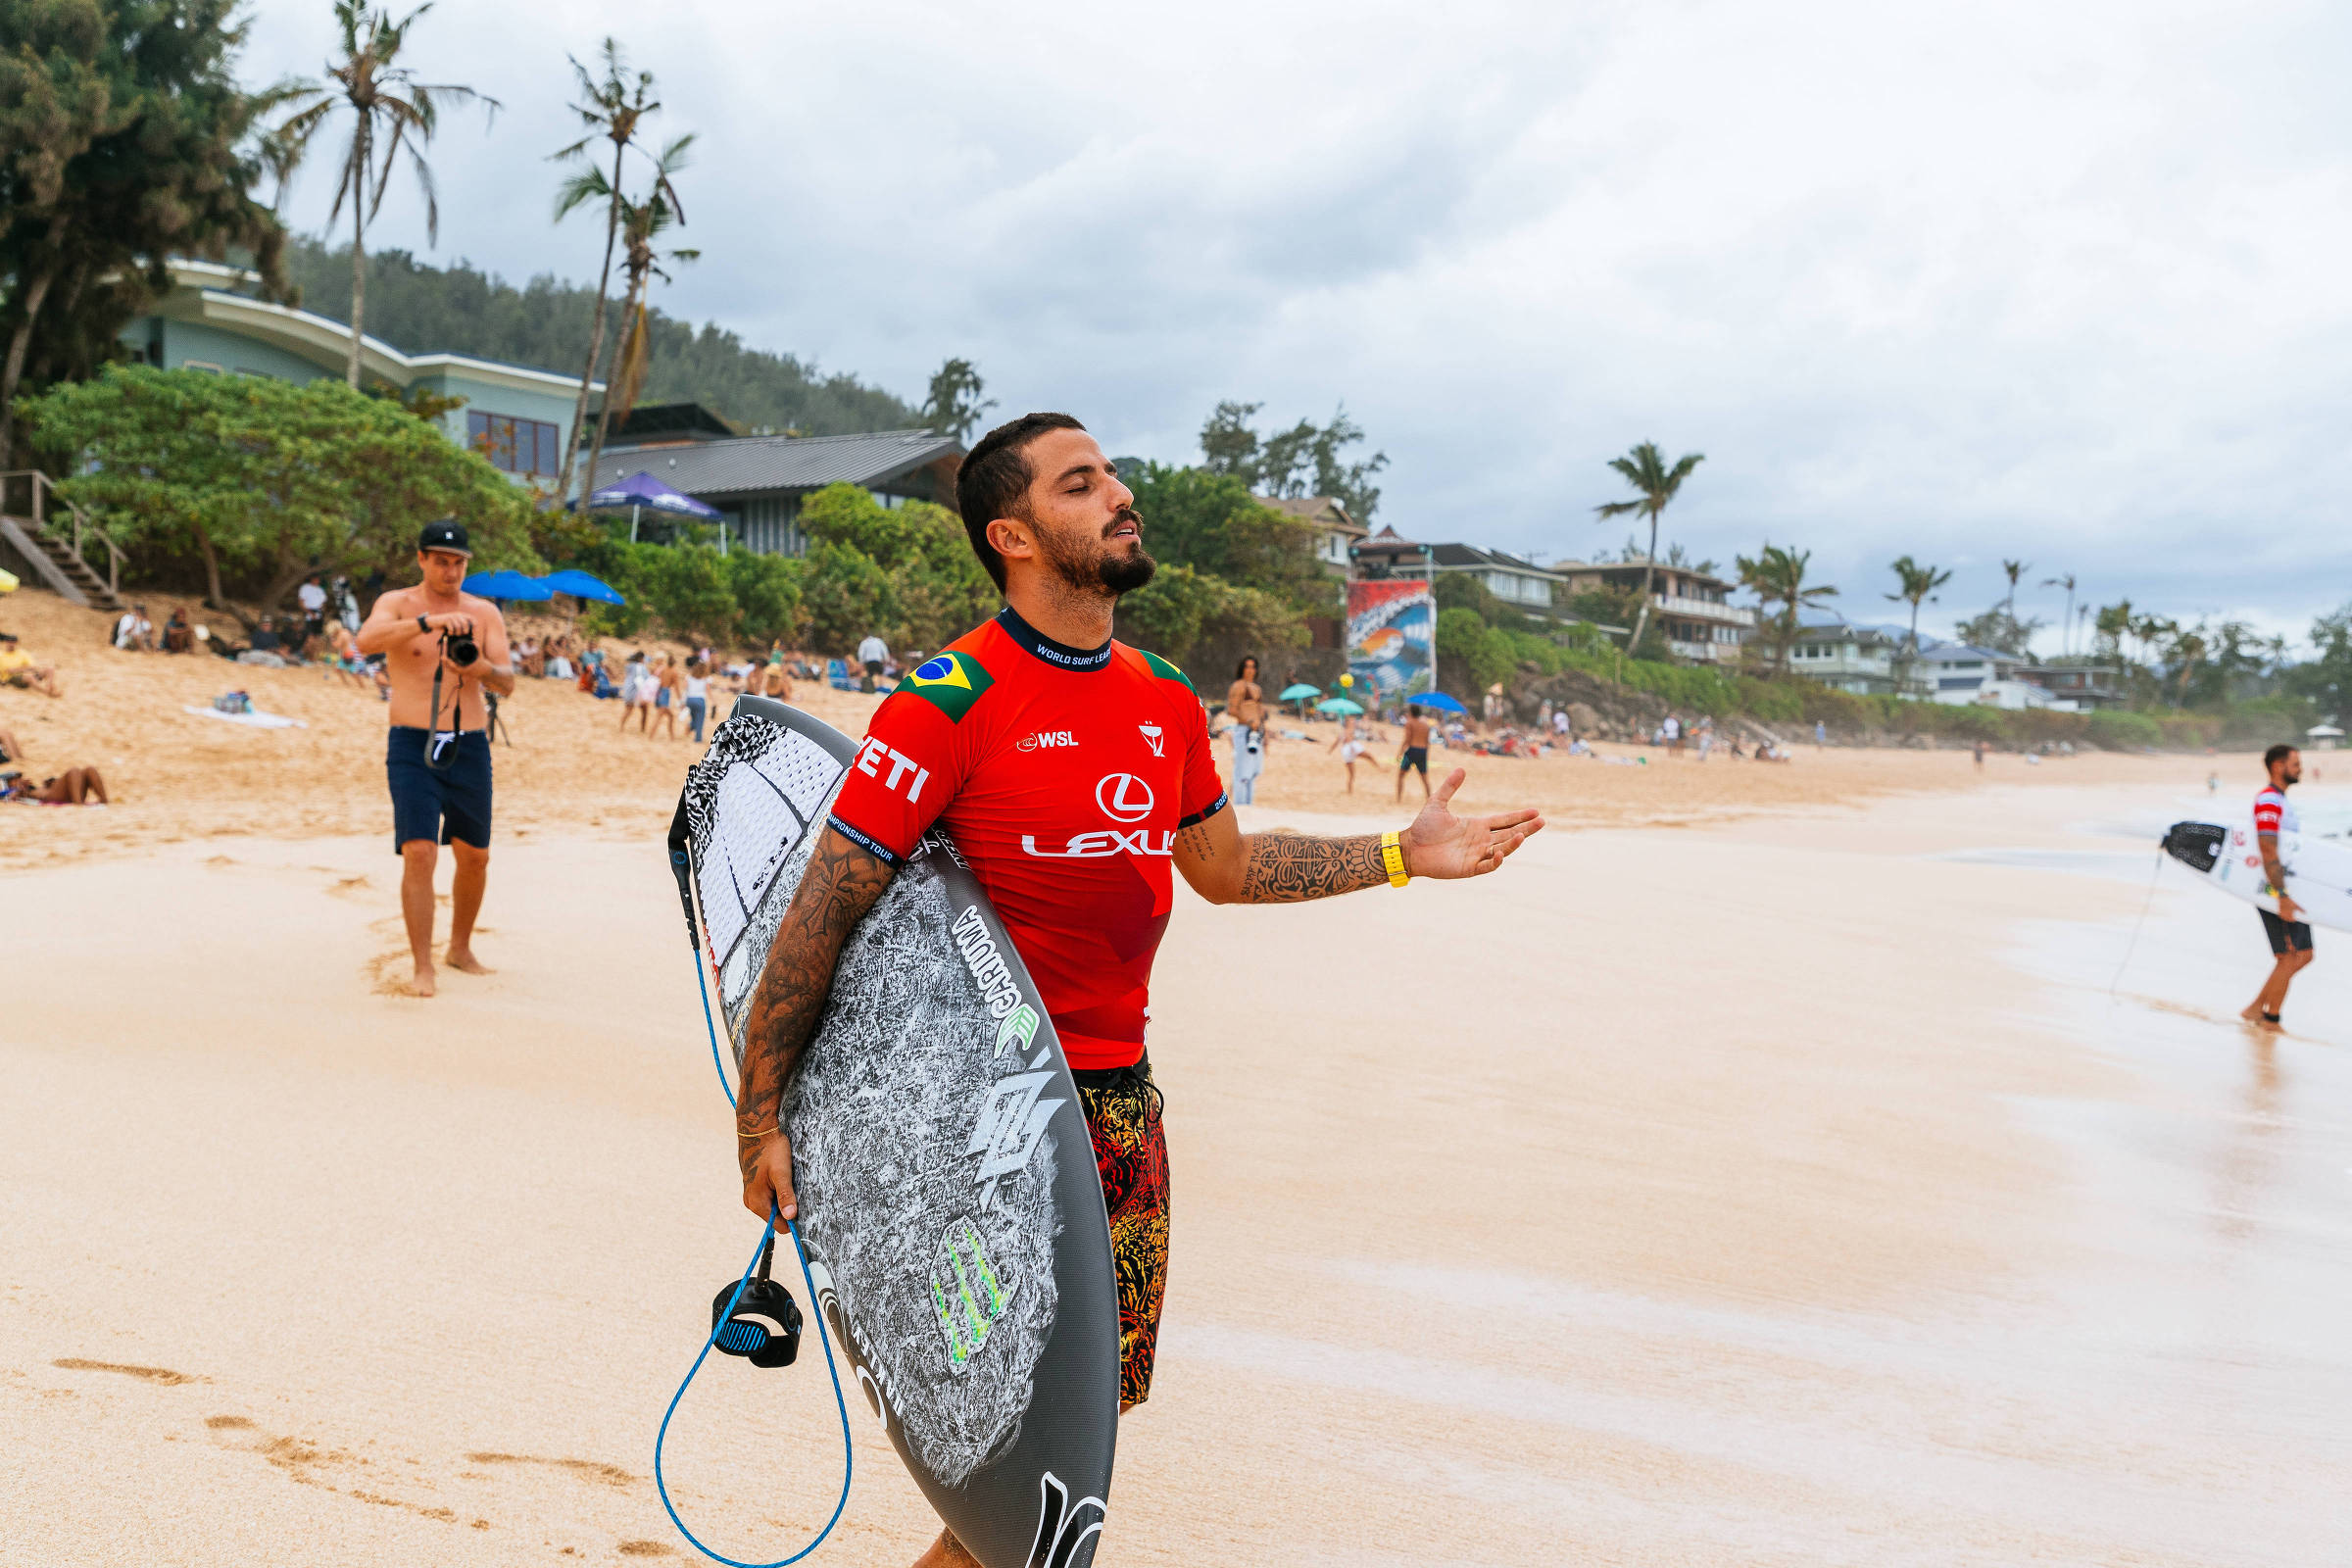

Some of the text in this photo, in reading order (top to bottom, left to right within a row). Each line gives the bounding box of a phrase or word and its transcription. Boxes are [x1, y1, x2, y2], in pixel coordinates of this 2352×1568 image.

[1037, 643, 1071, 664] WORLD
[1072, 656, 1096, 665] SURF
[1037, 730, 1079, 749] WSL
[868, 842, 893, 861] TOUR
[953, 906, 1021, 1017] CARIUMA
